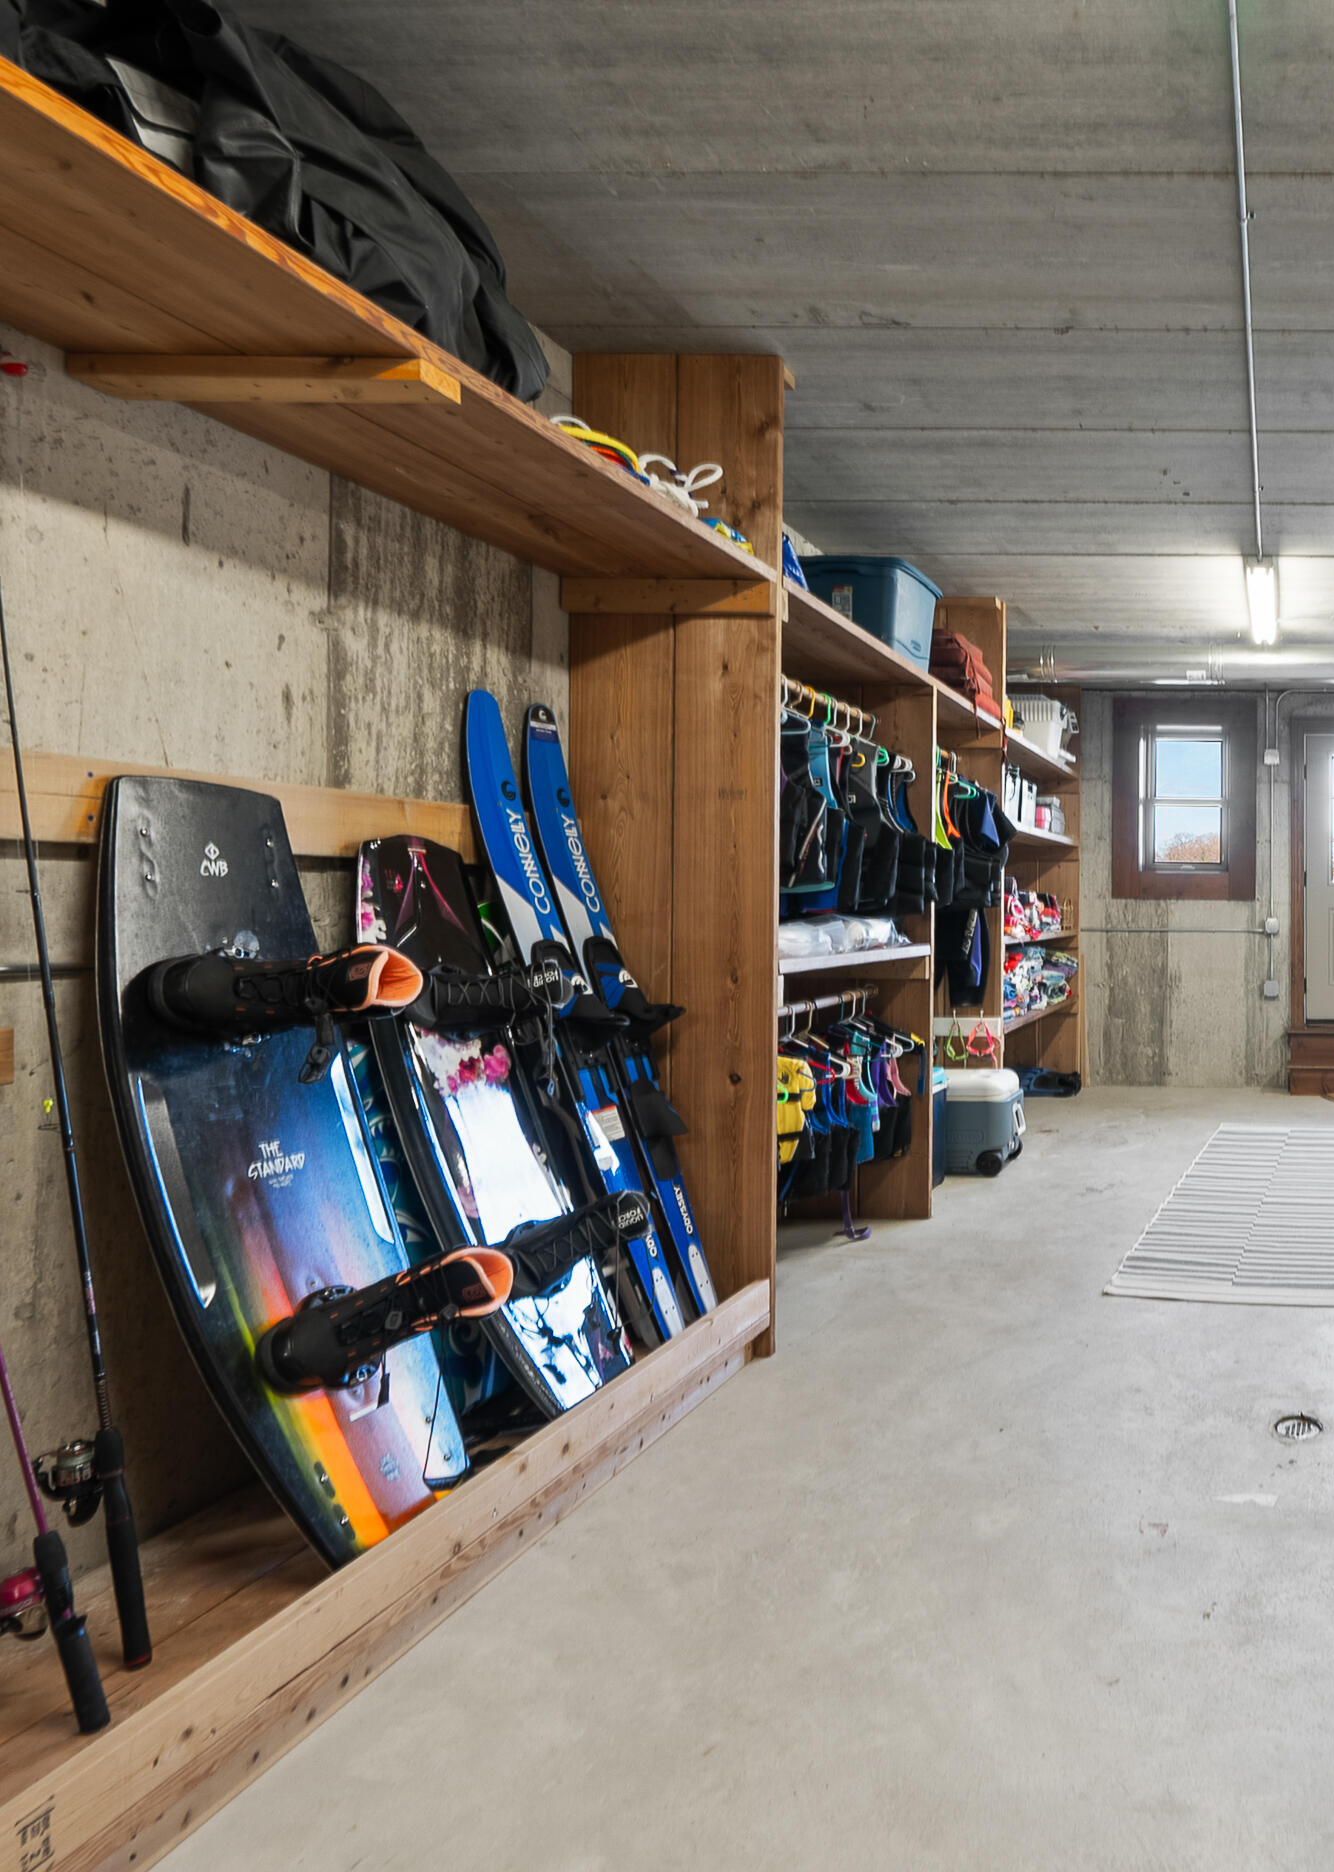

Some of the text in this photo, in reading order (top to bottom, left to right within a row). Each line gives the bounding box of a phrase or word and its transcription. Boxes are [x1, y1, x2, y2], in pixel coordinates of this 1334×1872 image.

[200, 858, 229, 877] CWB
[258, 1140, 283, 1159] THE
[248, 1152, 305, 1180] STANDARD
